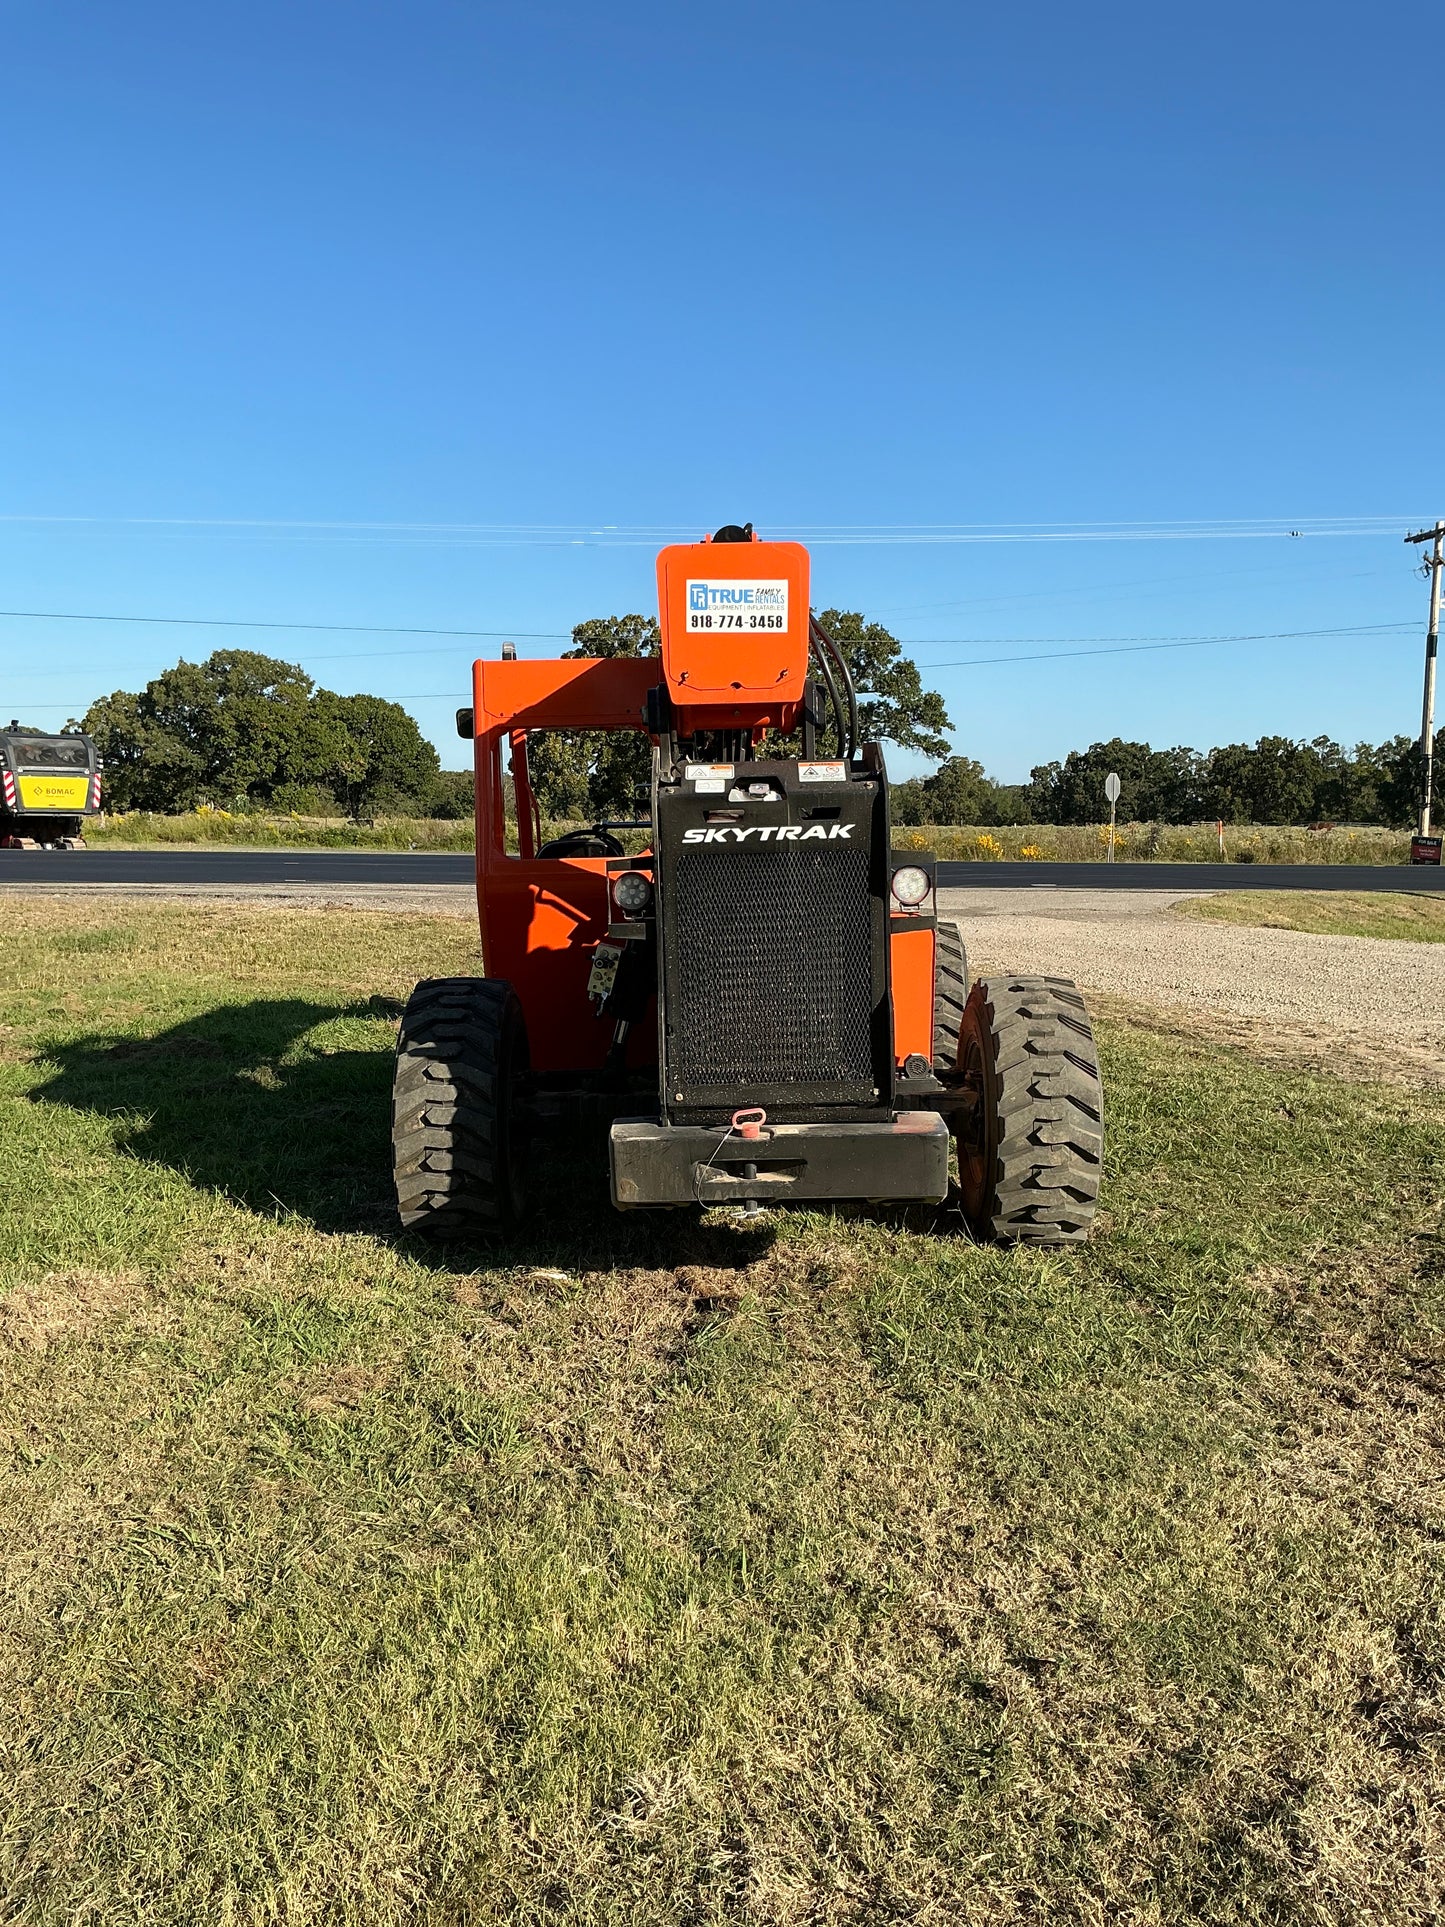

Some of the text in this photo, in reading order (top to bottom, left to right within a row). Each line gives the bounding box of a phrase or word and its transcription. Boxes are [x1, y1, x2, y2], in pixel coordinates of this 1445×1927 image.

[709, 589, 754, 603] TRUE
[755, 595, 785, 604] RENTALS
[691, 615, 783, 628] 918-774-3458
[682, 824, 856, 843] SKYTRAK
